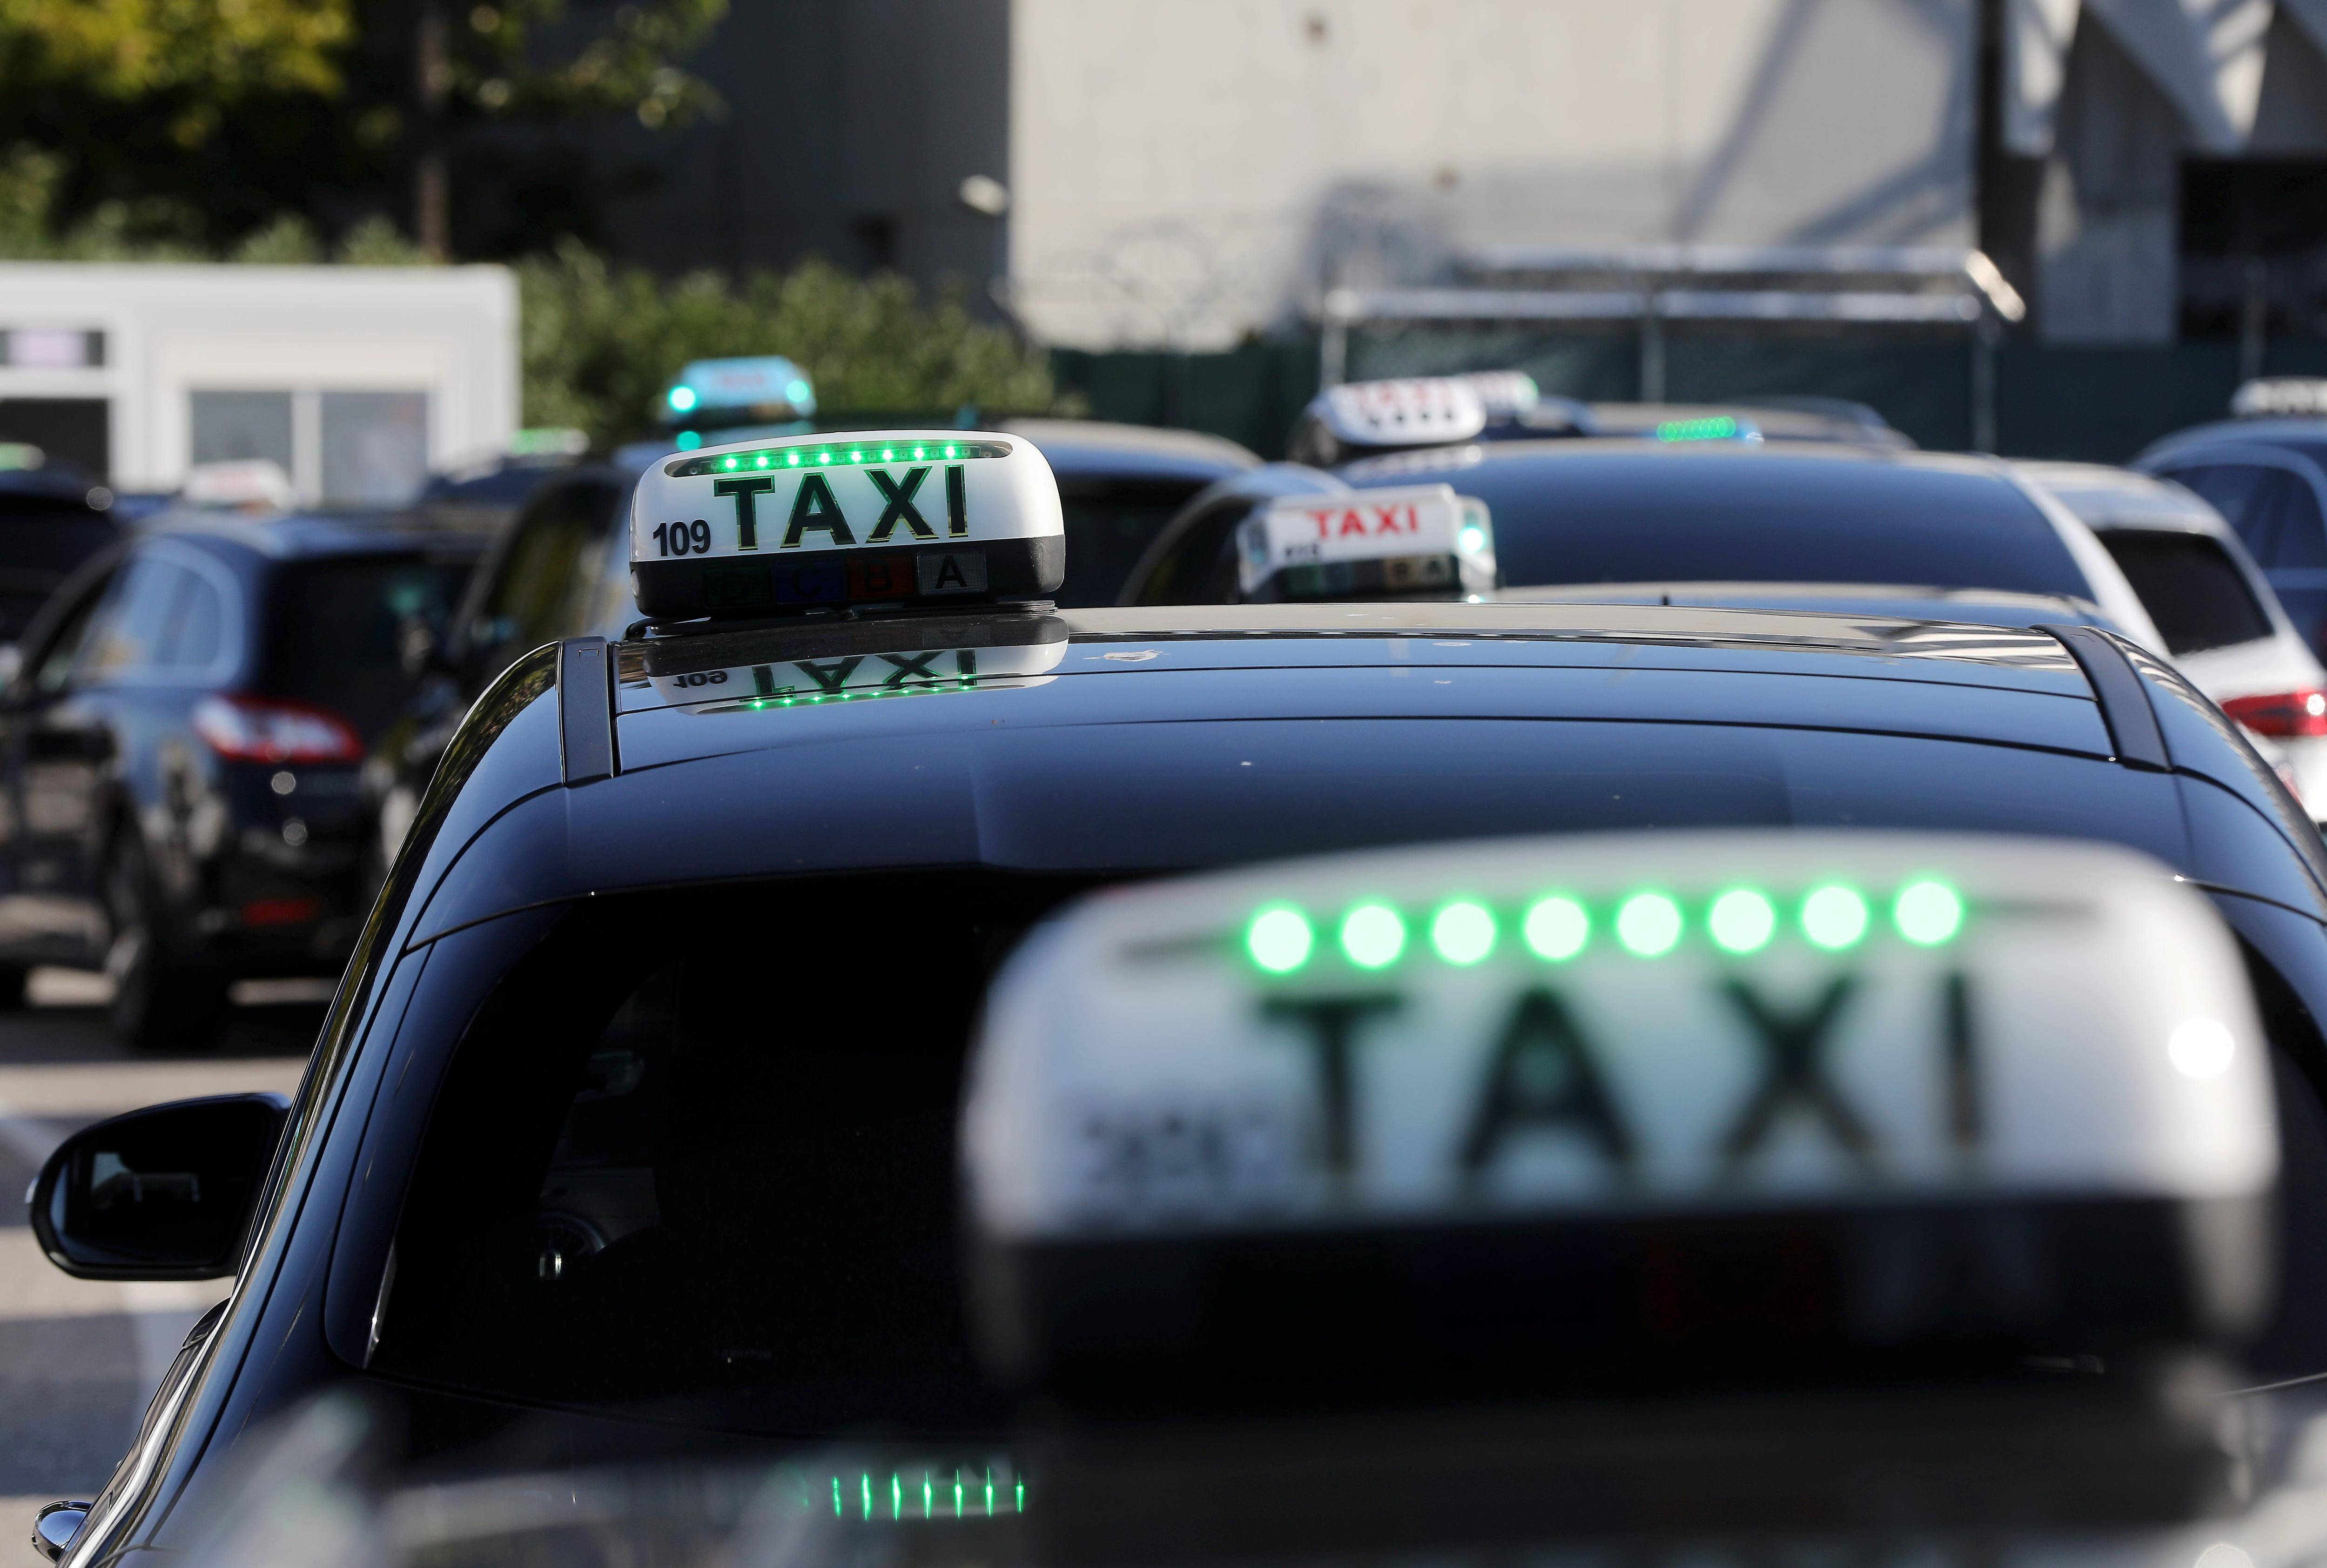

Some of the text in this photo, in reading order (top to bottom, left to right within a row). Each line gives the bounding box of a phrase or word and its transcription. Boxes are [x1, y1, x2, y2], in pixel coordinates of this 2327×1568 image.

[713, 464, 968, 551] TAXI
[1306, 503, 1419, 540] TAXI
[653, 519, 711, 556] 109
[793, 566, 823, 598] C
[865, 560, 894, 591] B
[936, 555, 967, 589] A
[1254, 969, 1984, 1175] TAXI
